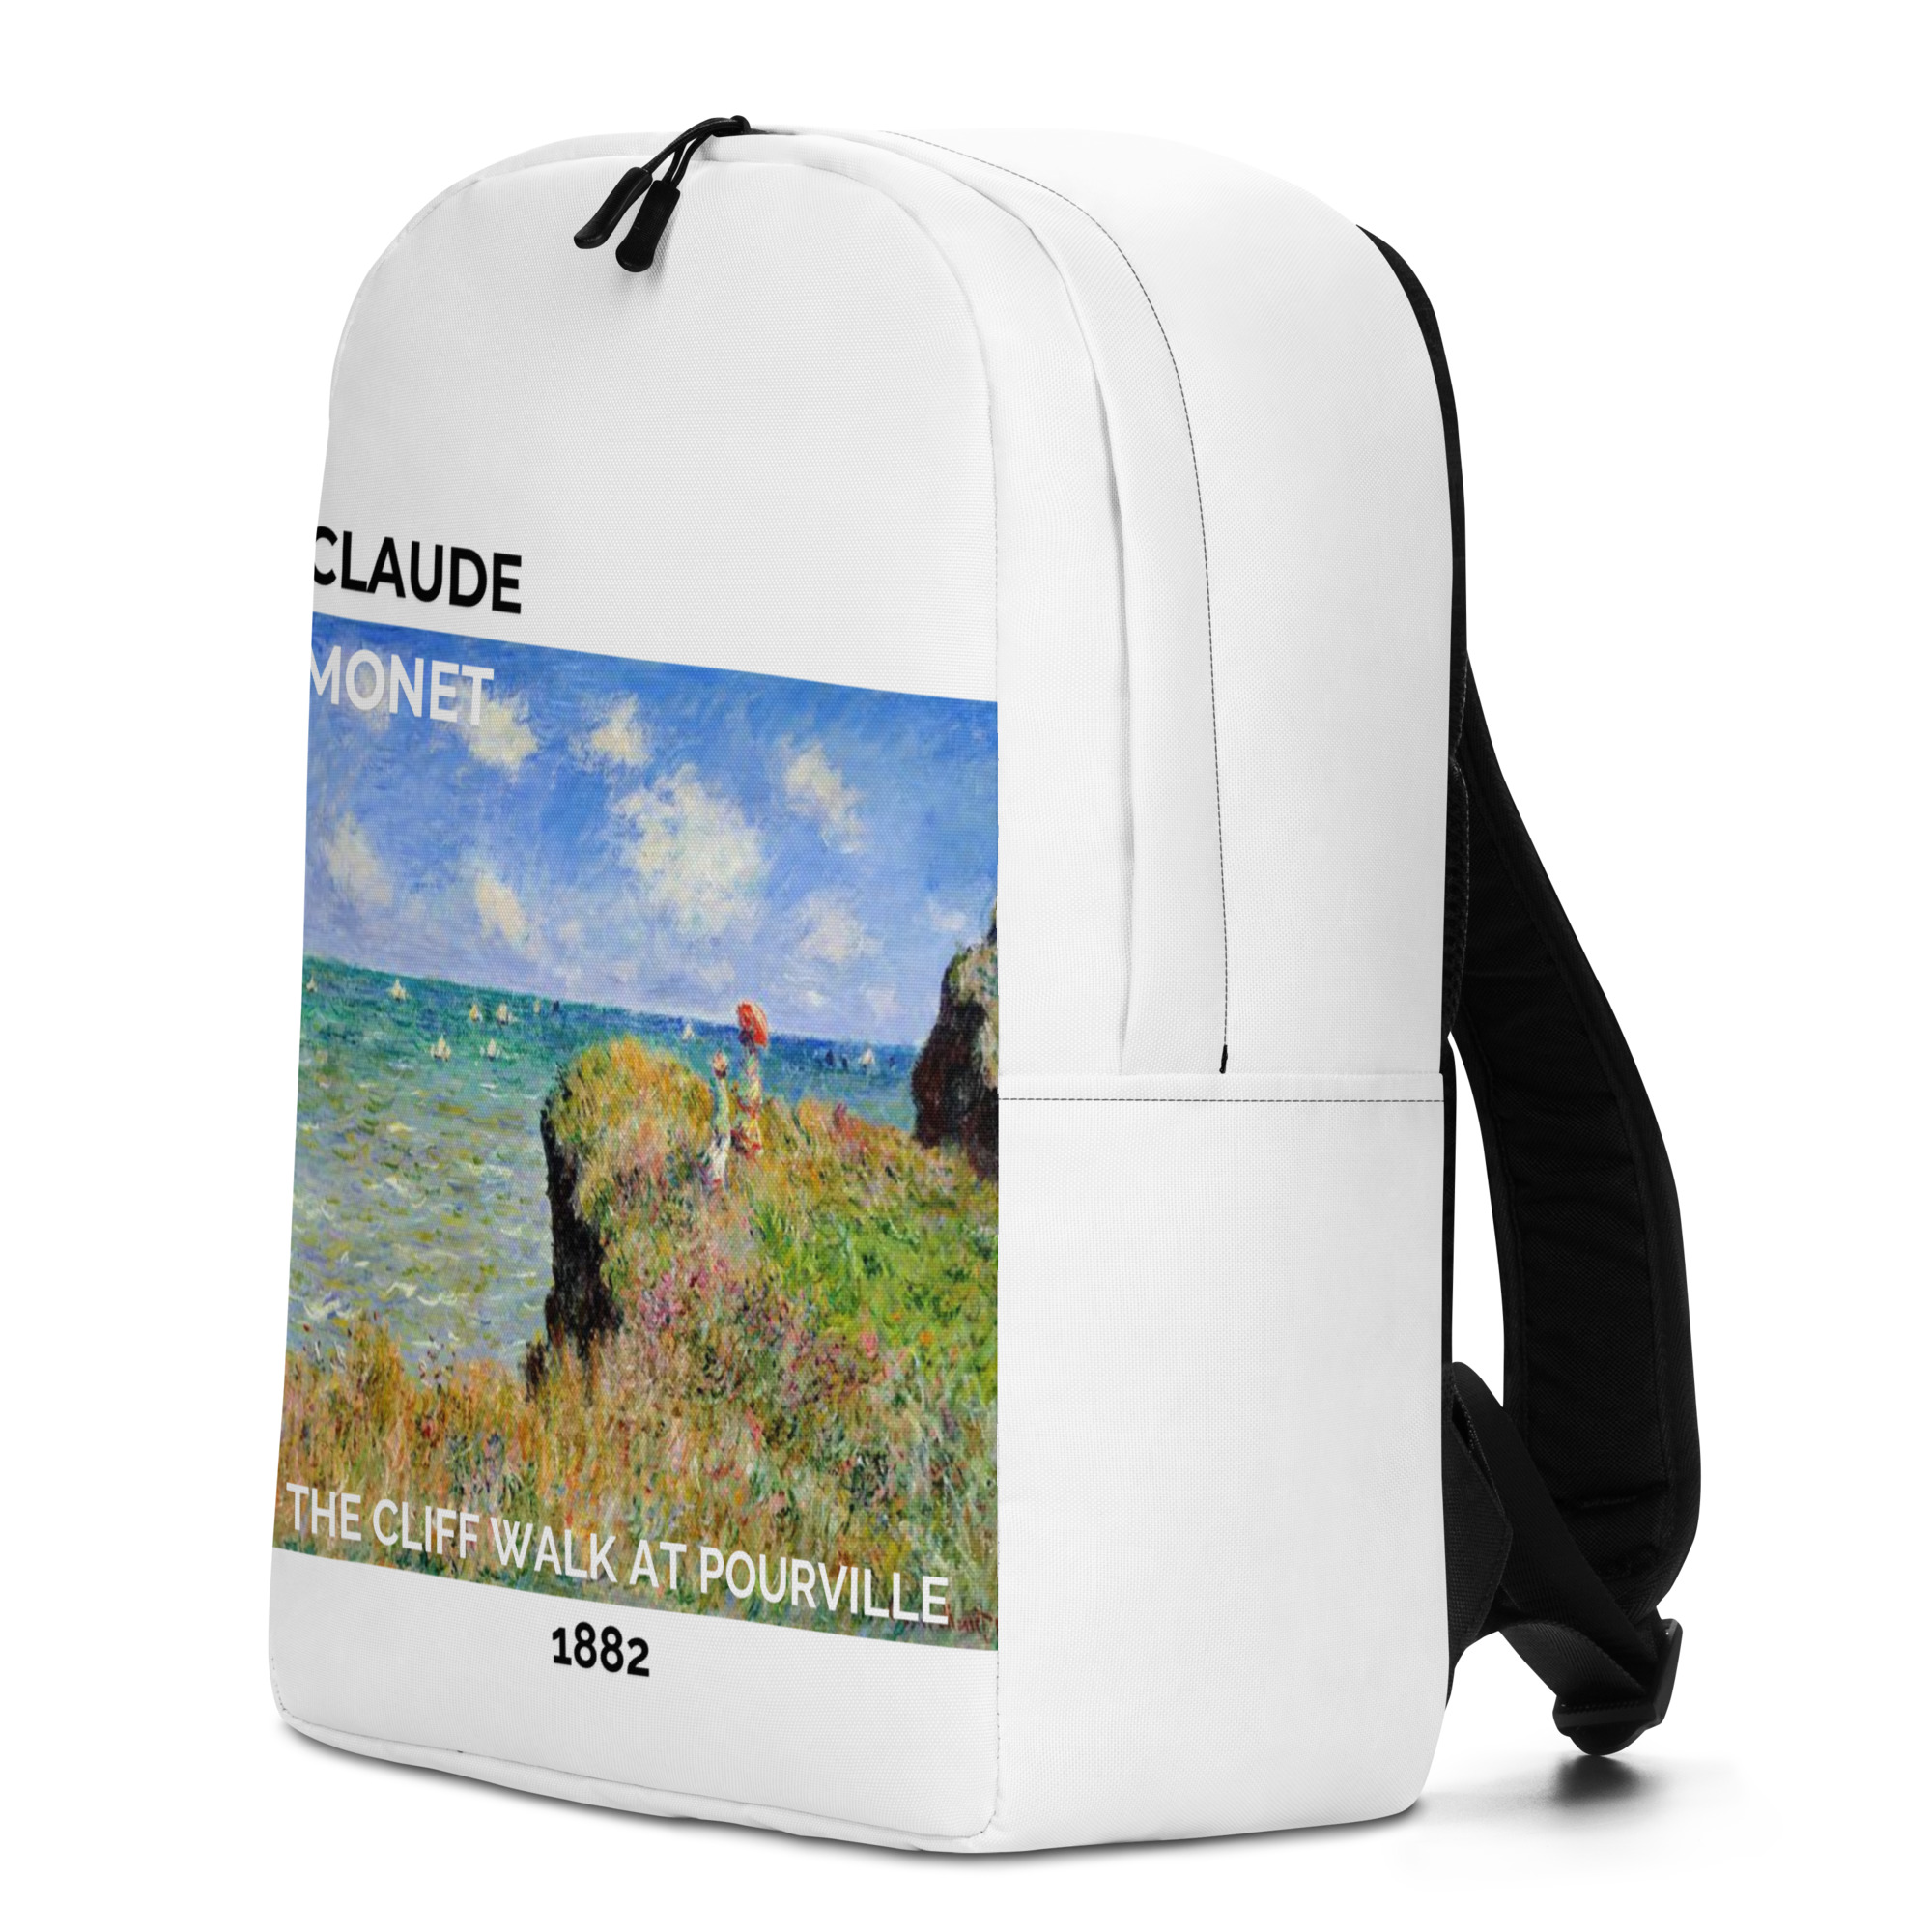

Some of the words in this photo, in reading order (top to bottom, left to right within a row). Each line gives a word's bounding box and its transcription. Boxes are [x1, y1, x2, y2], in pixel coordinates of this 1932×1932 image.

[314, 526, 522, 614] CLAUDE
[310, 645, 495, 725] MONET
[286, 1483, 362, 1542] THE
[373, 1499, 480, 1559] CLIFF
[490, 1517, 618, 1582] WALK
[629, 1539, 688, 1590] AT
[700, 1547, 949, 1625] POURVILLE
[552, 1621, 650, 1677] 1882
